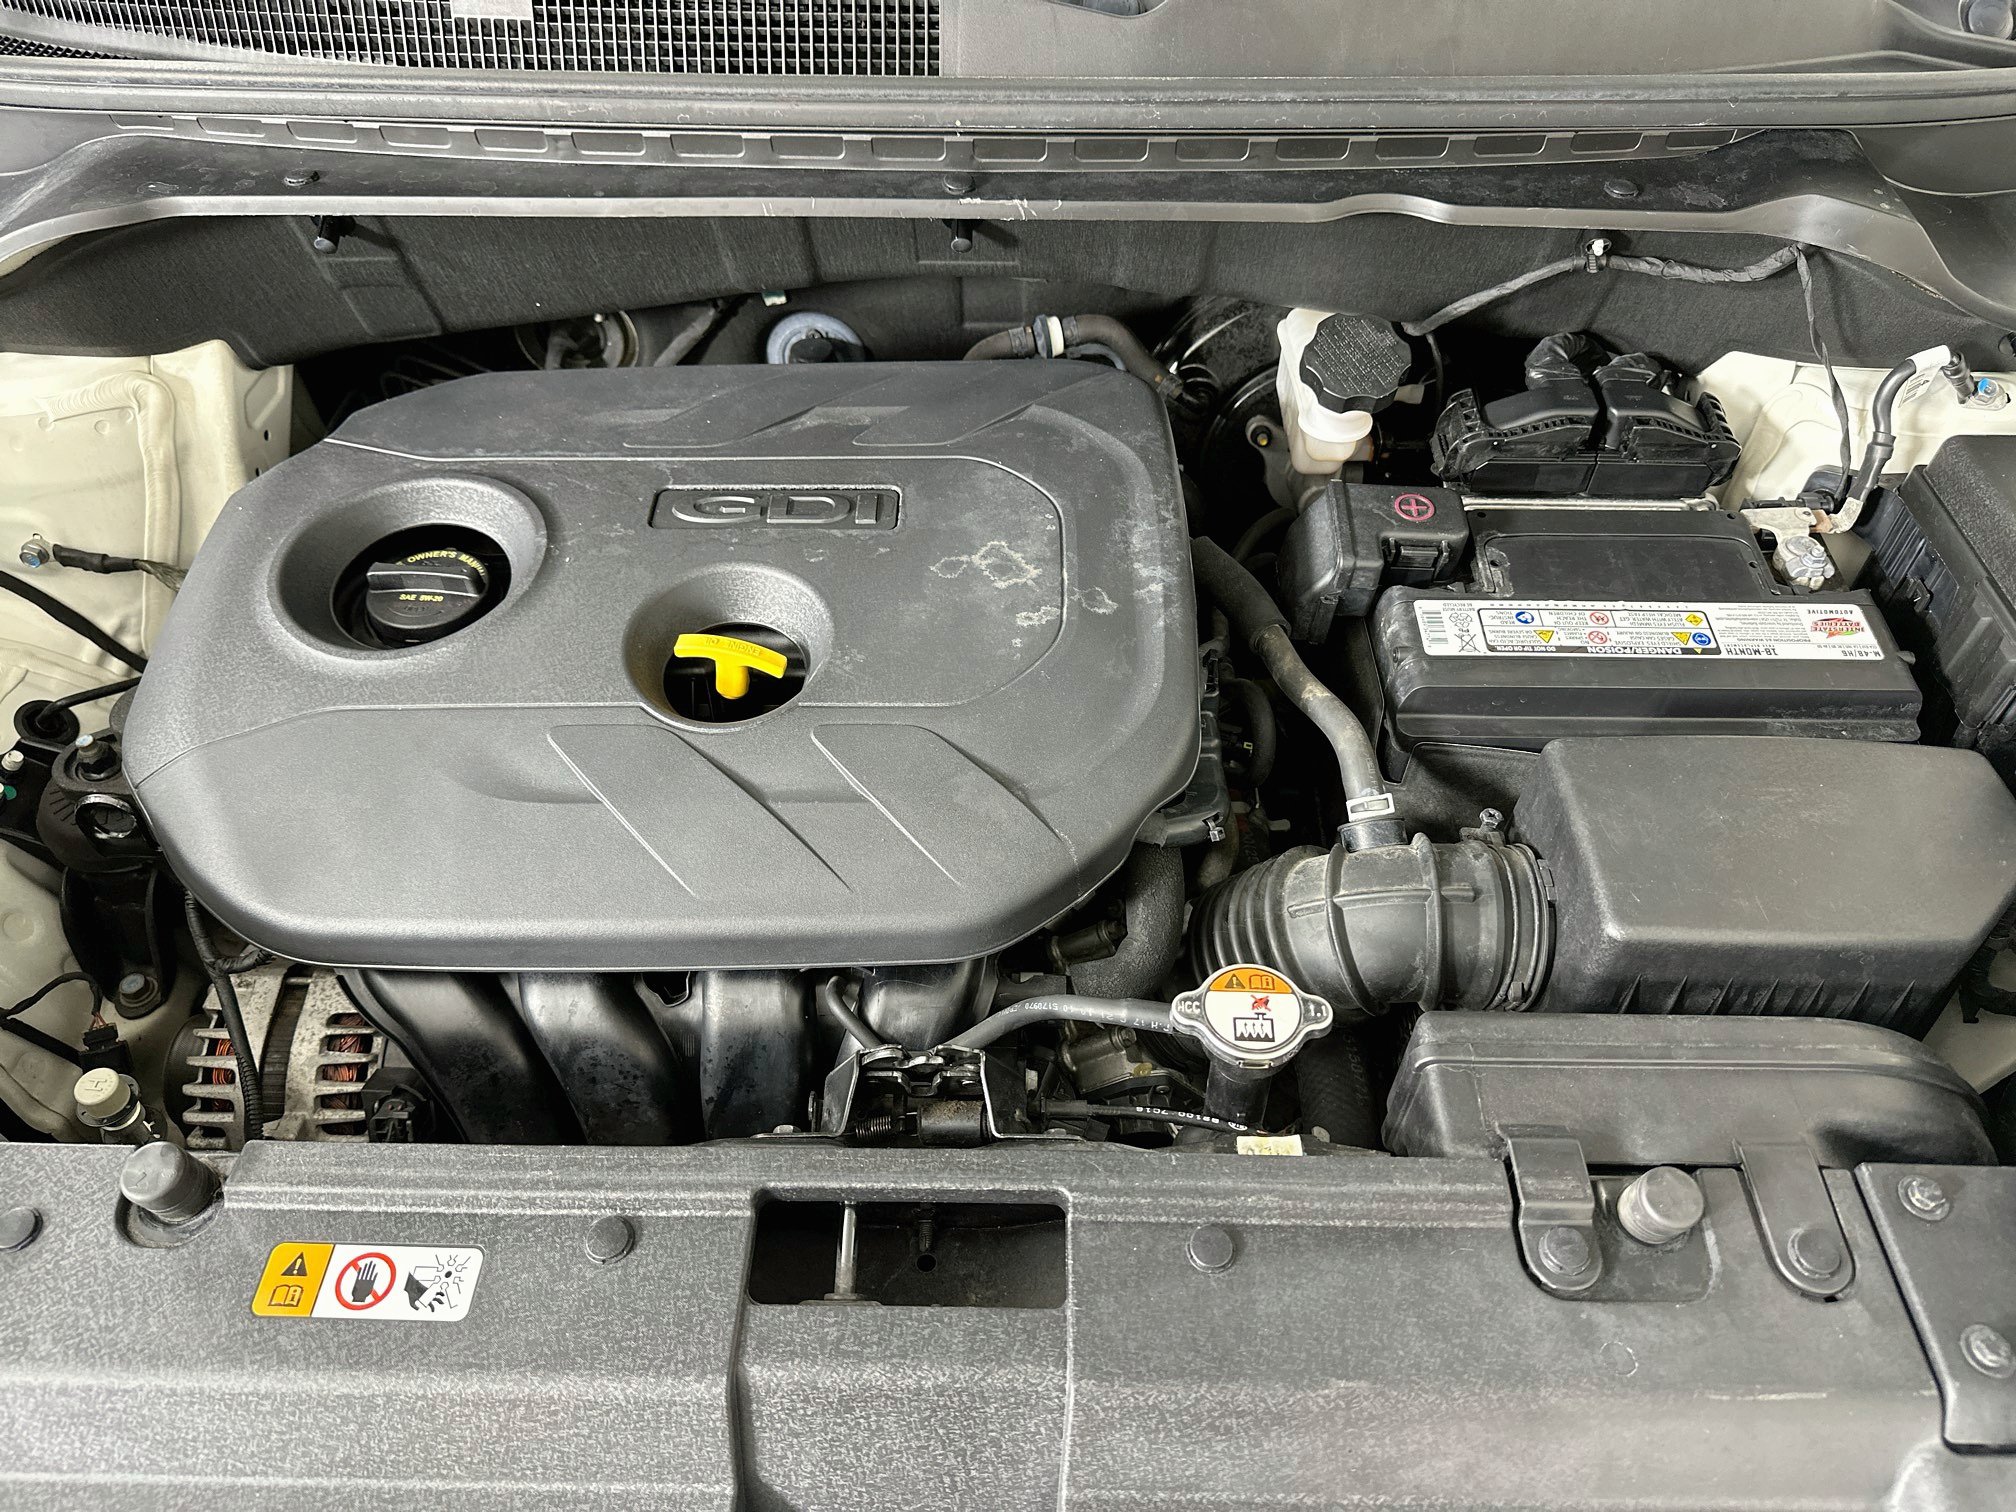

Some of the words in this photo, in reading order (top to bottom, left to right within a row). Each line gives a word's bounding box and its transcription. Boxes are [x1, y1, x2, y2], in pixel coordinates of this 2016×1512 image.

[672, 494, 877, 524] GDI
[407, 551, 457, 562] OWNER'S
[1177, 1002, 1200, 1011] HCC
[1310, 1004, 1326, 1016] 1.1
